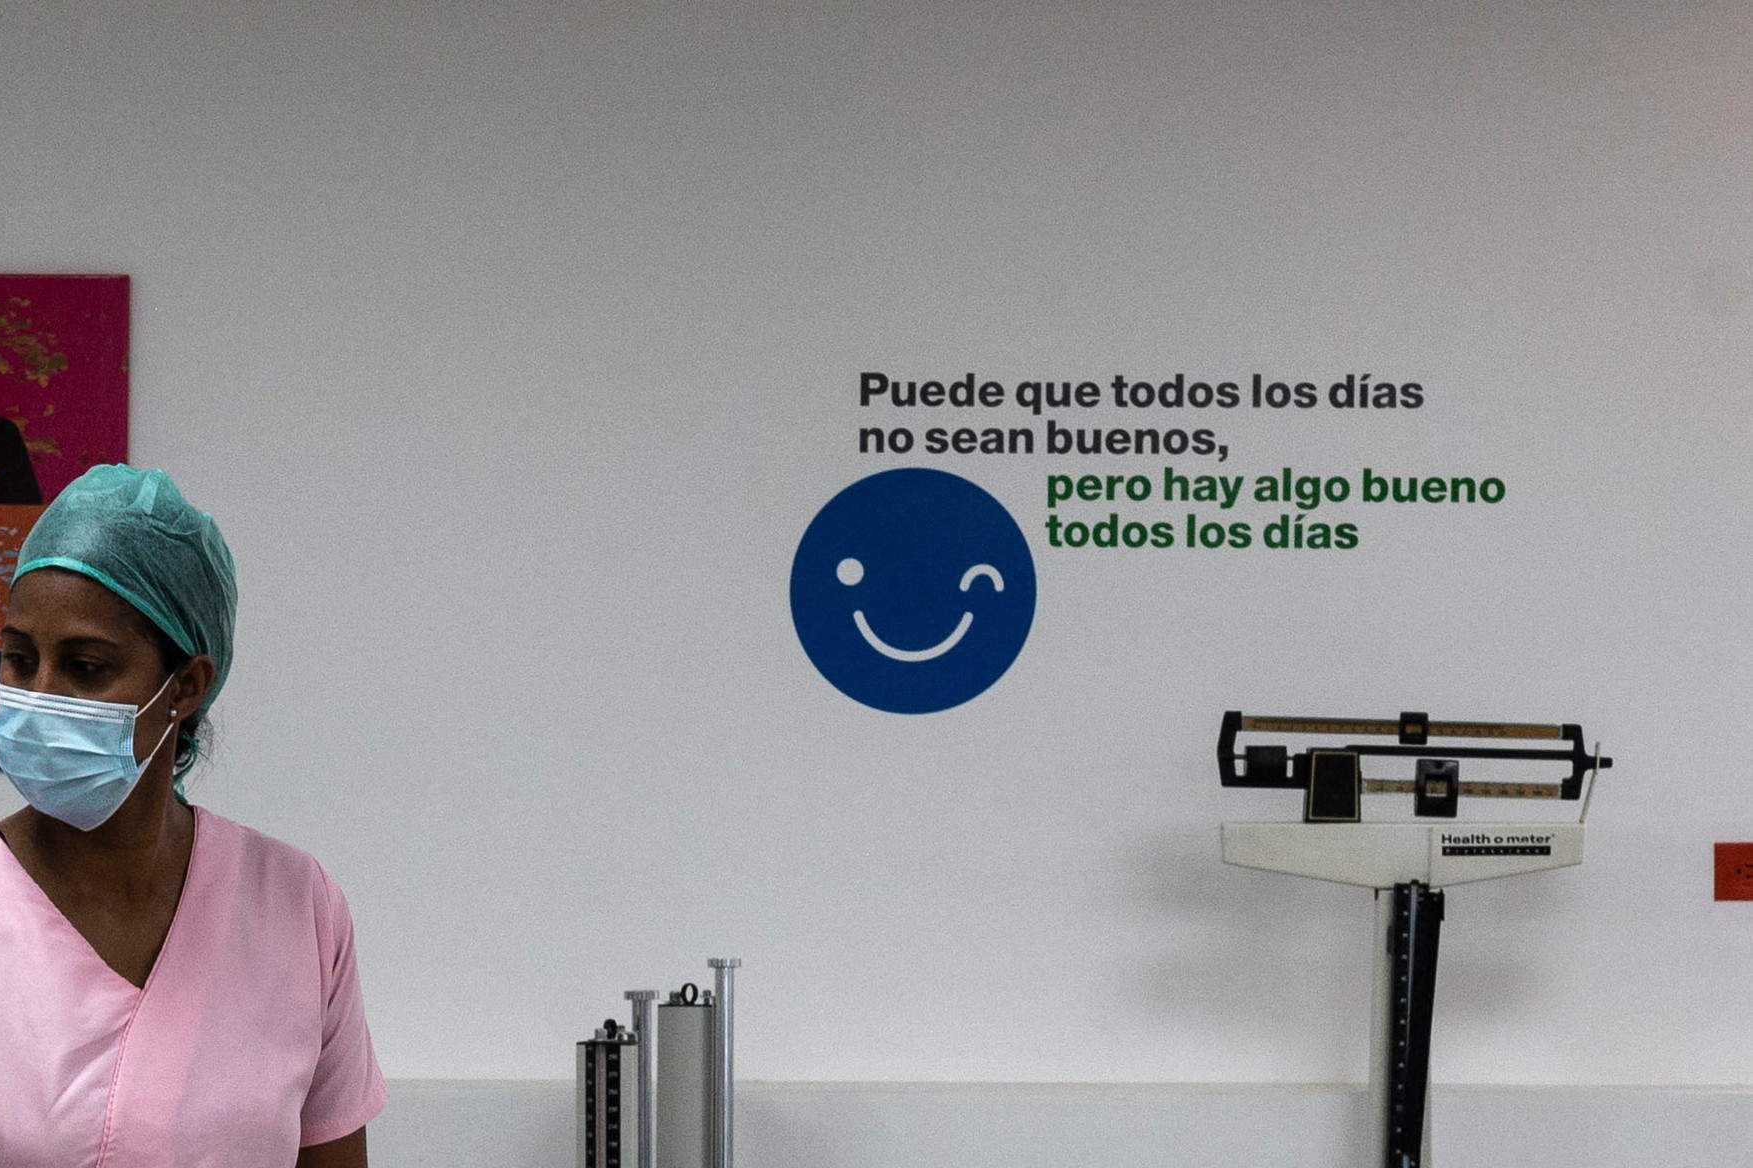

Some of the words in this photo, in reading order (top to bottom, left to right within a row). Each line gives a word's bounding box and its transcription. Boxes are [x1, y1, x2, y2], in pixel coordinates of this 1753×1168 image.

[859, 371, 1005, 408] Puede
[1015, 381, 1101, 416] que
[1111, 374, 1241, 409] todos
[1252, 373, 1318, 409] los
[1328, 373, 1424, 410] días
[859, 427, 915, 454] no
[925, 427, 1034, 455] sean
[1046, 420, 1229, 462] buenos,
[1047, 474, 1152, 509] pero
[1163, 466, 1244, 510] hay
[1253, 467, 1351, 511] algo
[1362, 467, 1506, 504] bueno
[1045, 513, 1175, 549] todos
[1186, 513, 1253, 549] los
[1262, 513, 1359, 550] días
[1441, 833, 1491, 845] Health
